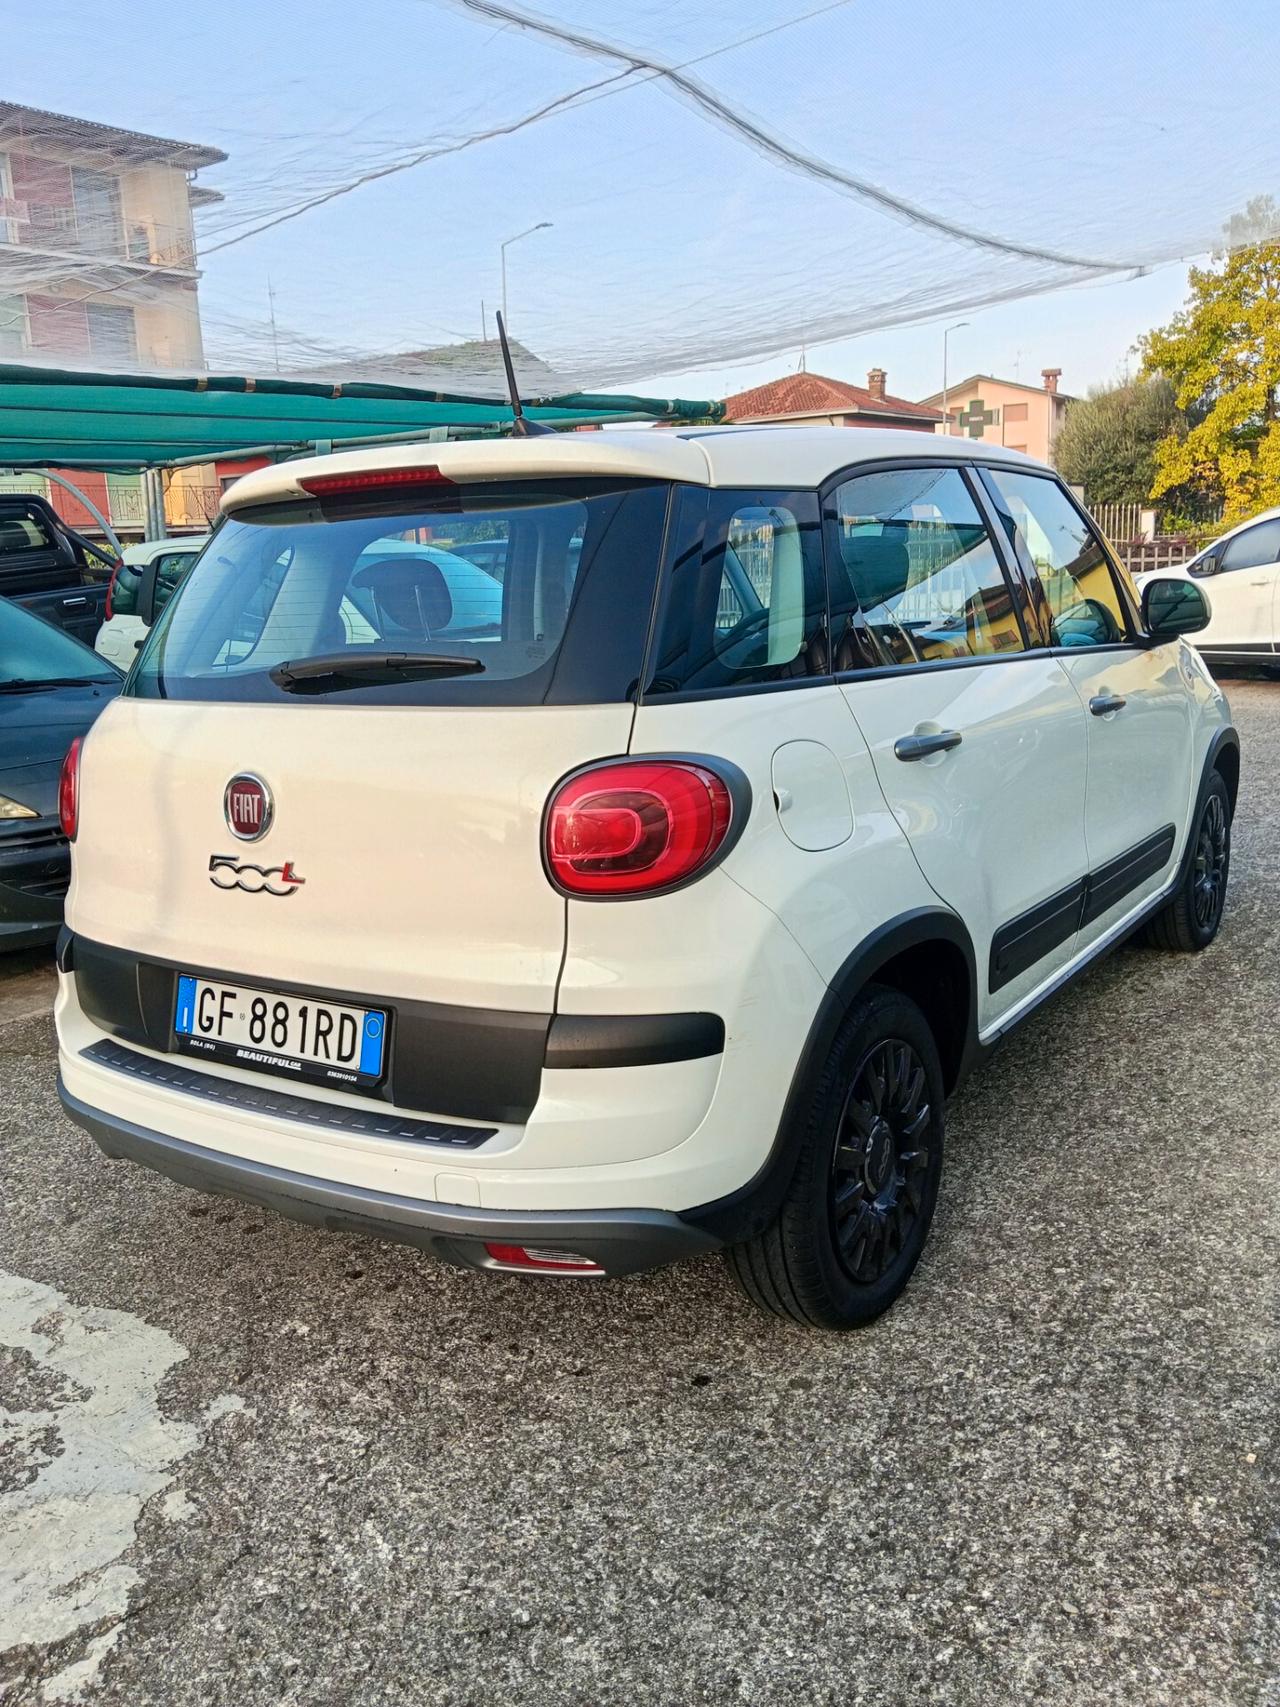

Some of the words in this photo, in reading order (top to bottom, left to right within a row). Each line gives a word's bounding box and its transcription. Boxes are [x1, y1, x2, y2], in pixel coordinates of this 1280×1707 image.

[233, 793, 260, 824] FIAT
[208, 854, 306, 896] 500L
[182, 1007, 188, 1027] I
[198, 987, 237, 1036] GF
[249, 997, 358, 1063] 881RD
[236, 1049, 291, 1068] BEAUTIFUL
